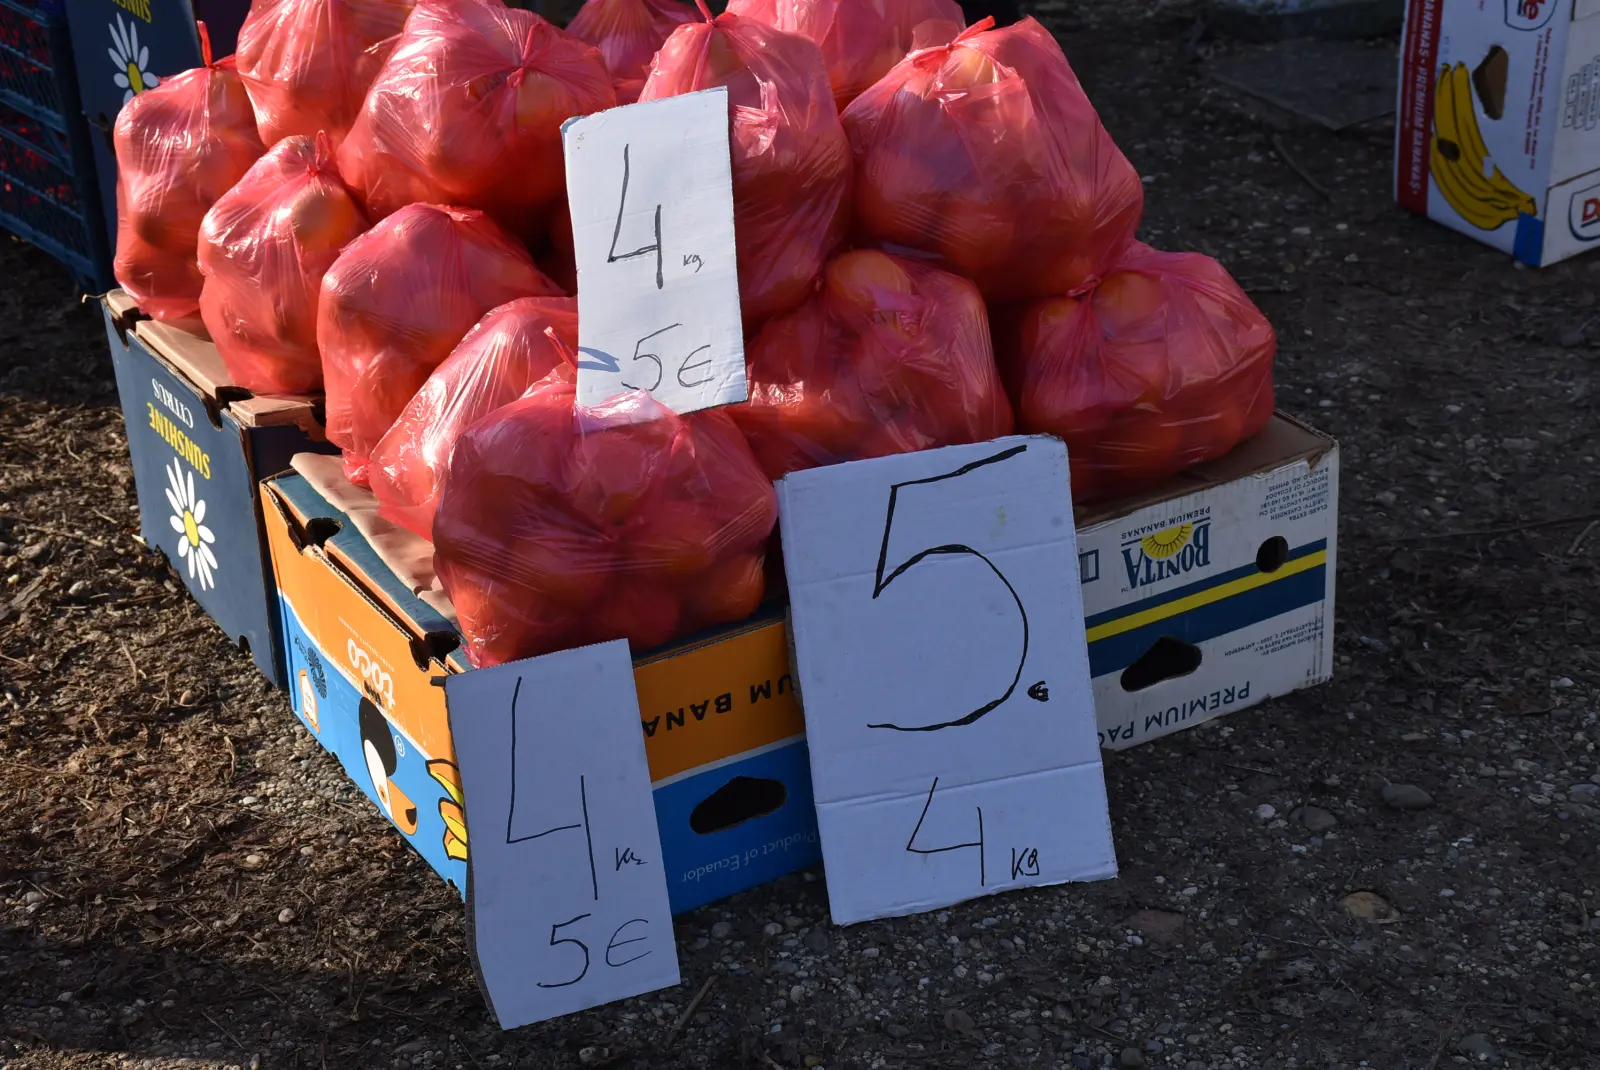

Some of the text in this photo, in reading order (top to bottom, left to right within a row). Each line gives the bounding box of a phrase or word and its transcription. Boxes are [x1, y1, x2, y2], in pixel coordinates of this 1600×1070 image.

[1418, 0, 1435, 58] ANANAS
[1413, 65, 1428, 128] PREMIUM
[1409, 128, 1424, 188] BANANAS
[607, 143, 663, 290] 4
[151, 378, 194, 429] CITRUS
[146, 401, 211, 480] SUNSHINE
[1265, 487, 1292, 501] ECUADOR
[1303, 474, 1329, 488] PRODUCT
[1121, 506, 1211, 540] PREMIUM BANANAS
[1270, 505, 1302, 521] CAVENDISH
[1289, 511, 1307, 521] EXTRA
[1120, 522, 1211, 589] BONITA
[1144, 680, 1250, 733] PREMIUM
[506, 676, 599, 901] 4
[681, 828, 816, 882] Product of Ecuador
[906, 777, 984, 887] 4
